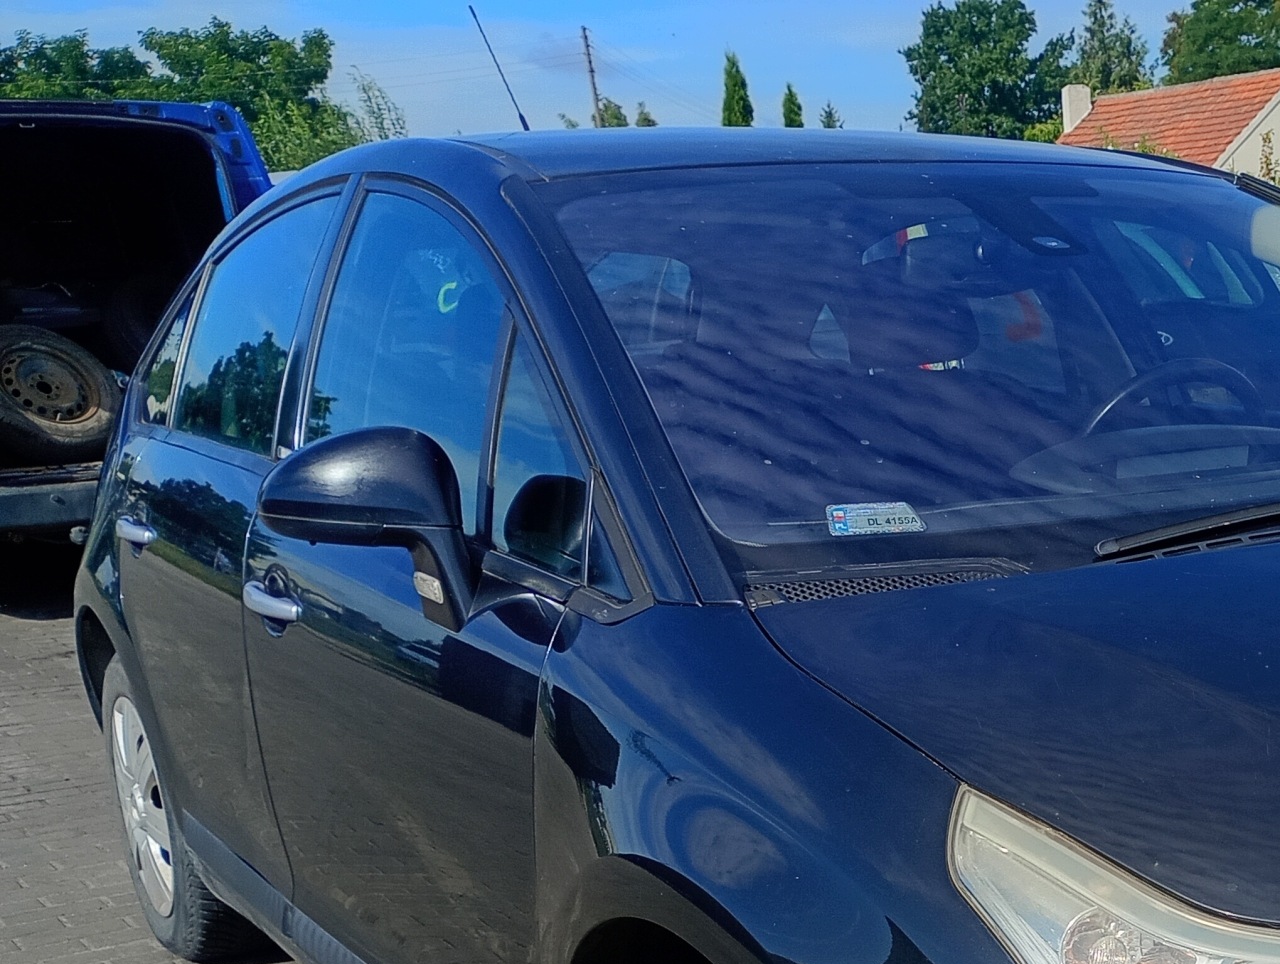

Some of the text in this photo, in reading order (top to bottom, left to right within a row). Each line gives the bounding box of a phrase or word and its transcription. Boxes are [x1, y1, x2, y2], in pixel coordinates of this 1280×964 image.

[437, 281, 459, 313] C
[868, 516, 918, 526] DL 4155A
